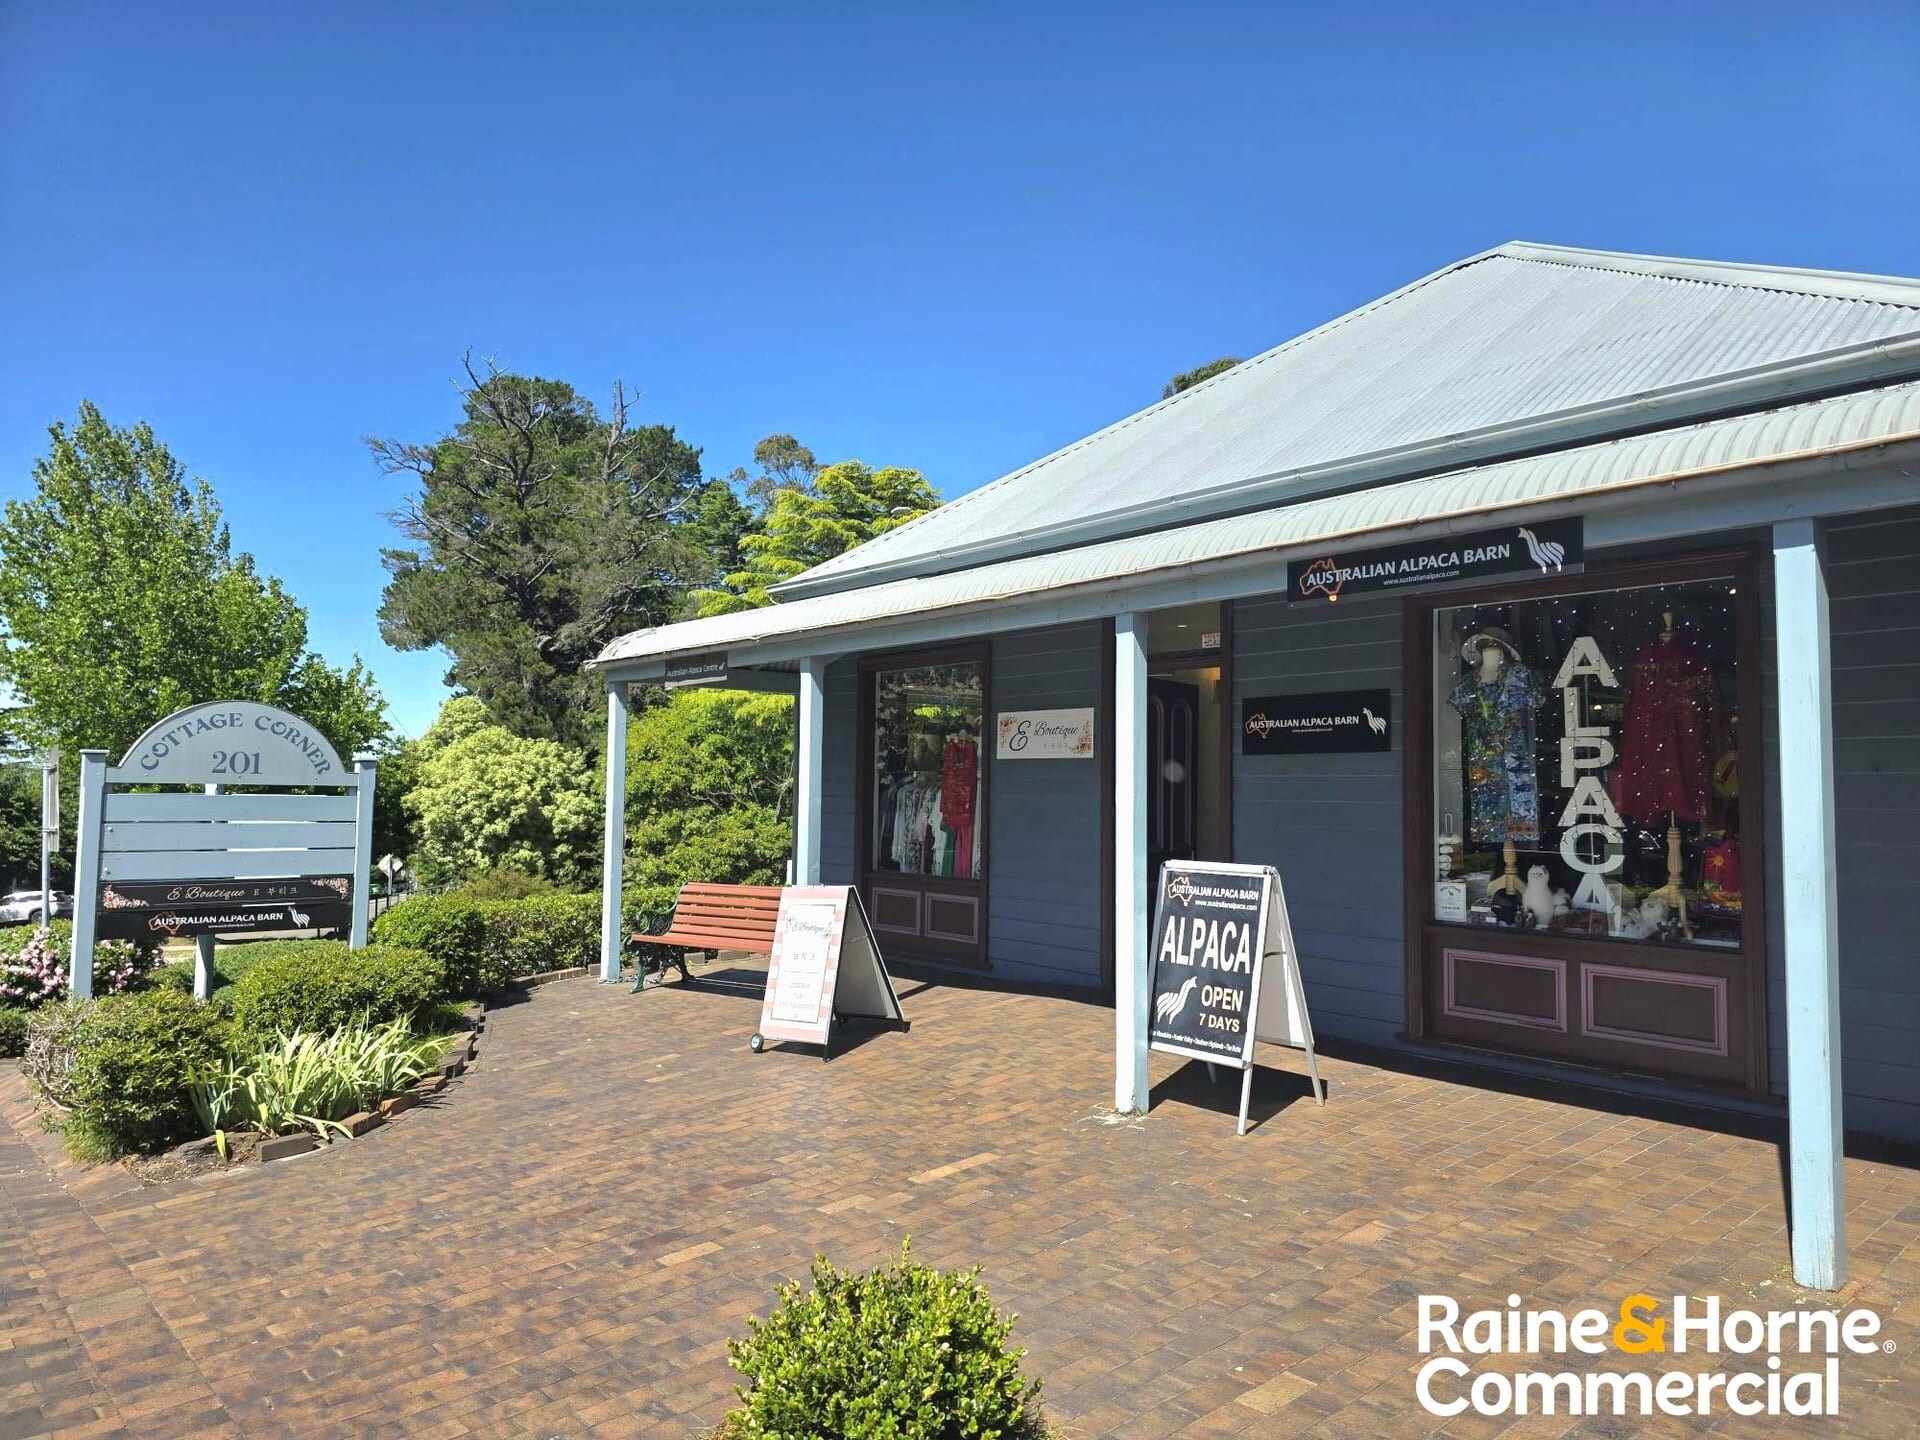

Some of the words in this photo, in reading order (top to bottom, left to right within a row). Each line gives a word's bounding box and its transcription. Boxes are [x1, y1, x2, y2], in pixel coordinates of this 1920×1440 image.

[1306, 561, 1396, 587] AUSTRALIAN
[1398, 551, 1460, 573] ALPACA
[1463, 543, 1511, 564] BARN
[1383, 569, 1460, 586] www.australianalpaca.com
[1249, 719, 1300, 729] AUSTRALIAN
[1300, 717, 1333, 727] ALPACA
[1334, 715, 1360, 725] BARN
[140, 712, 244, 771] COTTAGE
[254, 715, 332, 776] CORNER
[1009, 720, 1031, 751] E
[1033, 721, 1078, 740] Boutique
[211, 750, 263, 775] 201
[1551, 635, 1626, 914] ALPACA
[185, 886, 245, 902] Boutique
[1172, 884, 1211, 897] AUSTRALIAN
[1211, 886, 1239, 899] ALPACA
[1239, 890, 1259, 901] BARN
[154, 915, 217, 927] AUSTRALIAN
[218, 913, 256, 923] ALPACA
[257, 912, 284, 921] BARN
[1160, 915, 1252, 975] ALPACA
[1201, 984, 1244, 1012] OPEN
[1199, 1012, 1206, 1026] 7
[1208, 1015, 1240, 1033] DAYS
